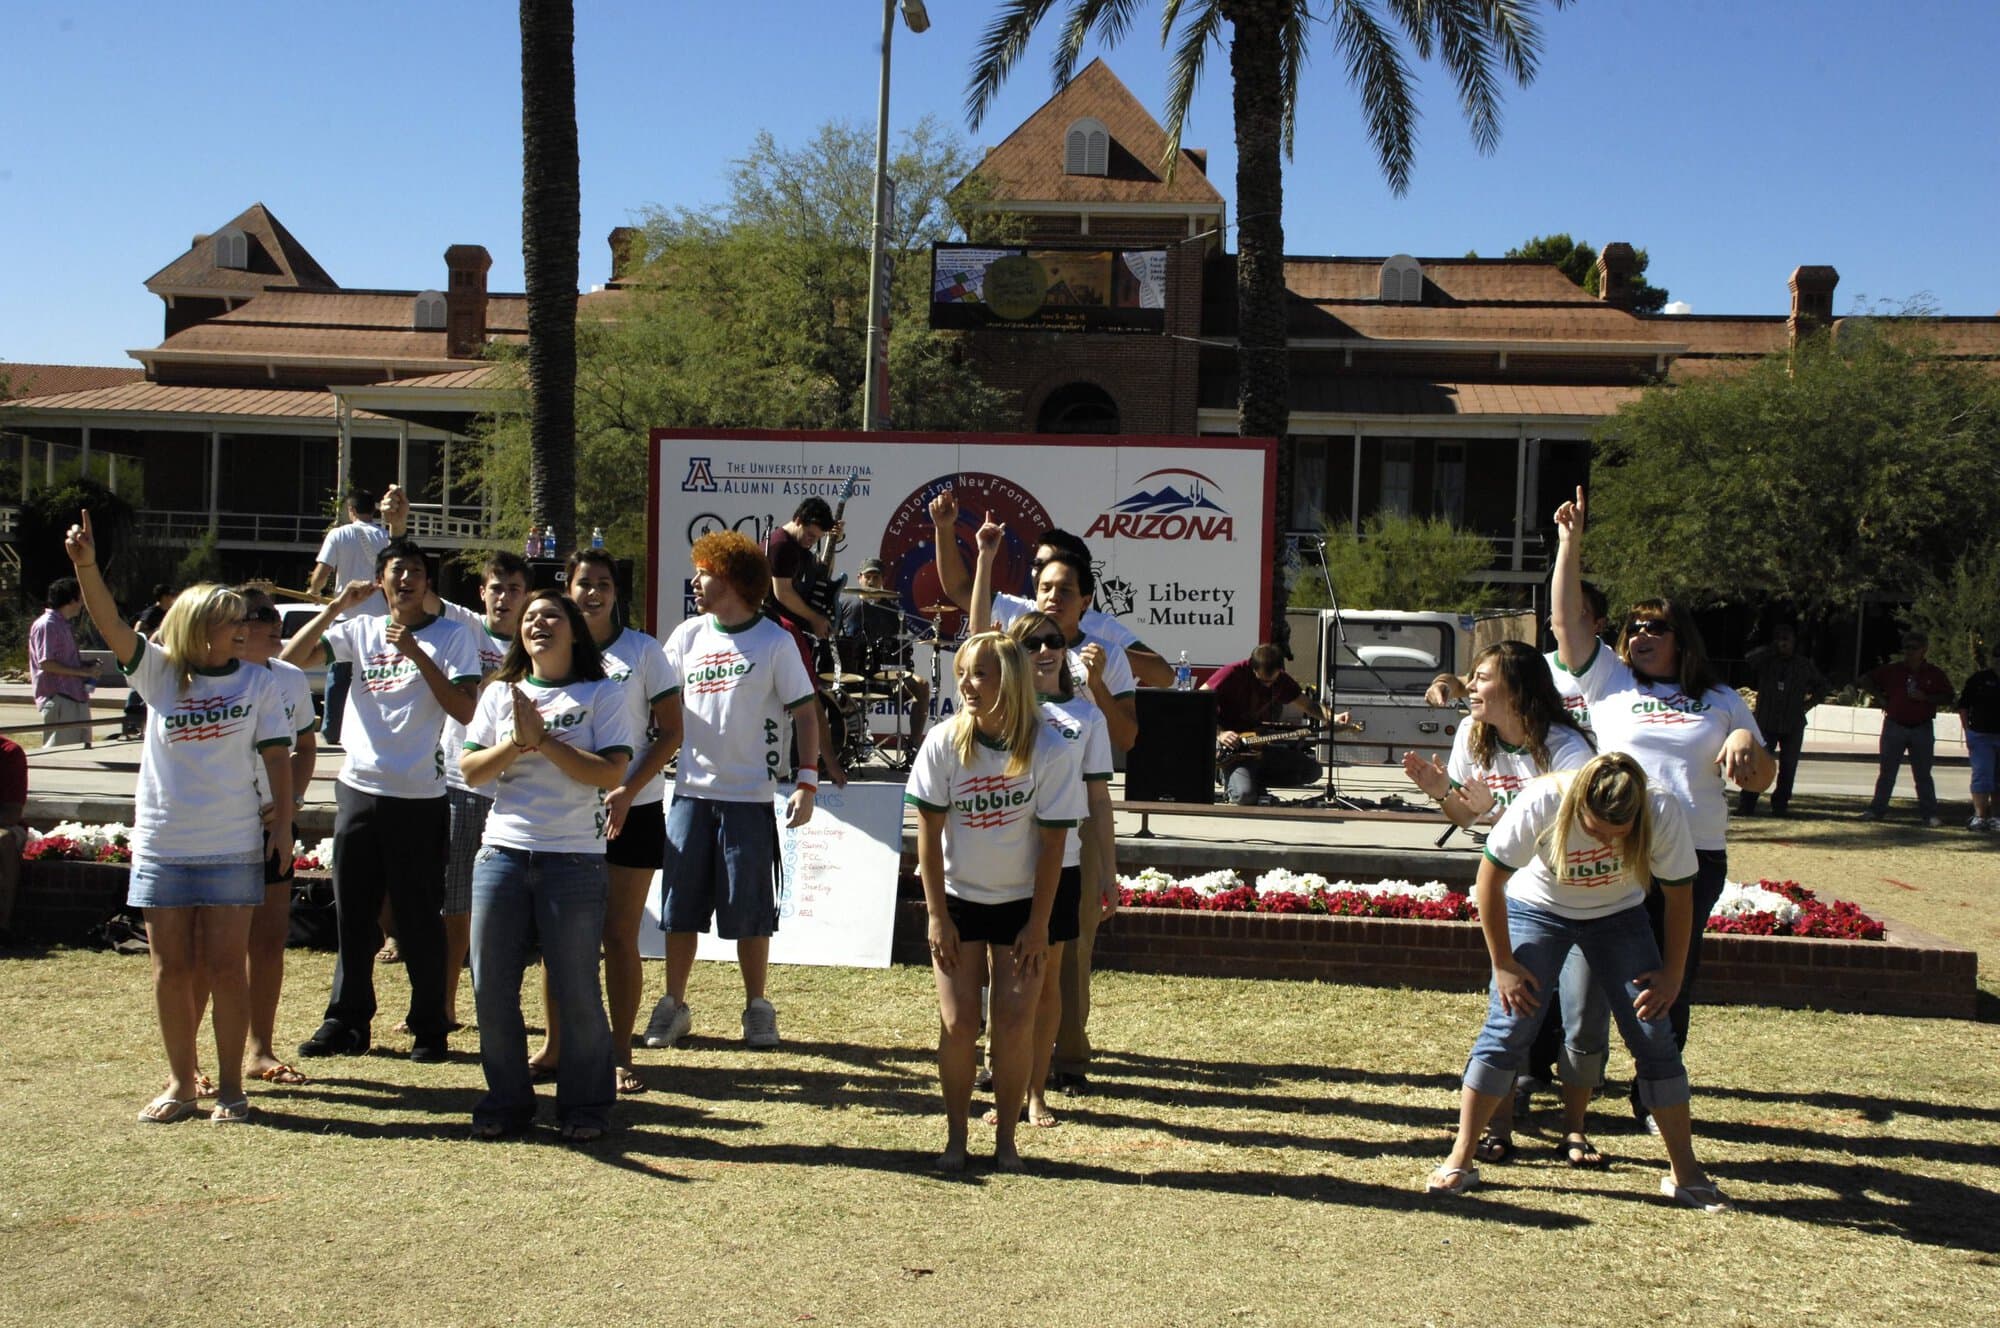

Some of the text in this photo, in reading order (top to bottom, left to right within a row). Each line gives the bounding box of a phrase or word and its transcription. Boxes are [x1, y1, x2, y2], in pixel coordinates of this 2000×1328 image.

[727, 462, 872, 475] THE UNIVERSITY OF ARIZONA
[724, 479, 870, 496] ALUMNI ASSOCIAON
[959, 476, 985, 487] New
[1083, 513, 1233, 542] ARIZONA
[1149, 582, 1235, 607] Liberty
[1149, 606, 1235, 626] Mutual
[360, 663, 419, 682] cubbie
[687, 662, 757, 684] cubbies
[165, 703, 253, 729] cubbies
[954, 783, 1037, 812] cubbies
